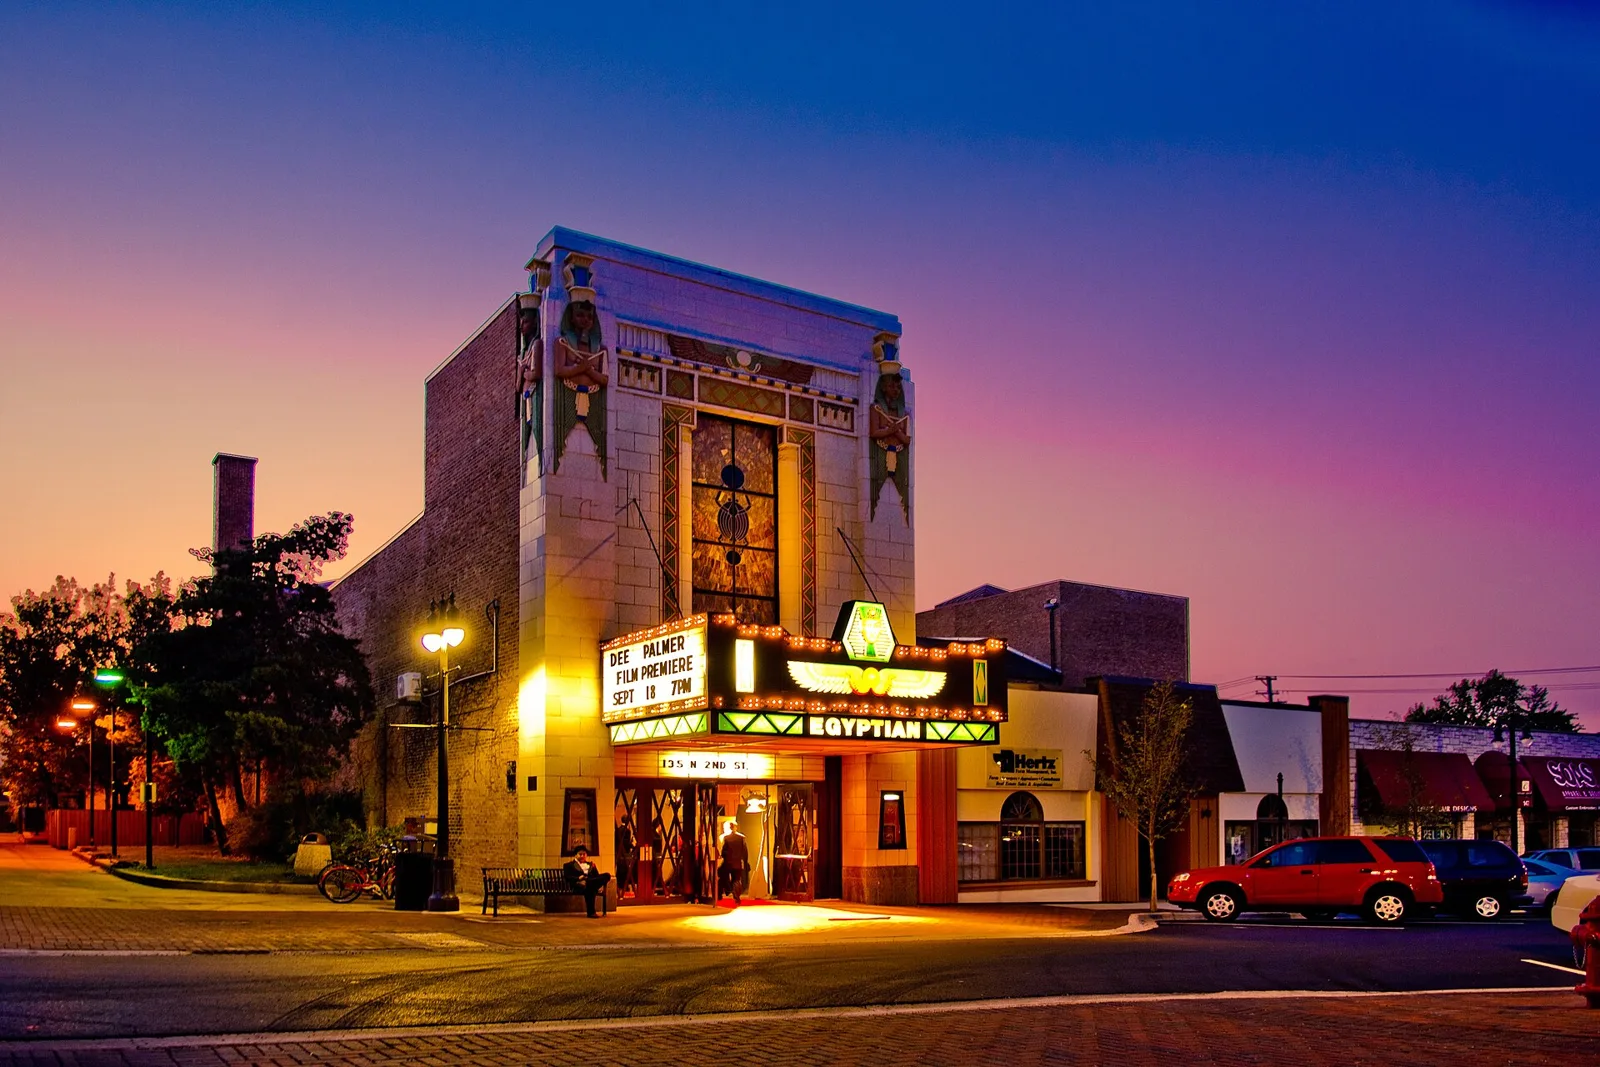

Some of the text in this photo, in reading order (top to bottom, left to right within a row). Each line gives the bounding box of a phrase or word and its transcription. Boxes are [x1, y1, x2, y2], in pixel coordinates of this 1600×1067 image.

[610, 635, 685, 667] DEE PALMER
[616, 655, 693, 685] FILM PREMIERE
[613, 677, 692, 705] SEPT 18 7PM
[809, 716, 921, 739] EGYPTIAN
[662, 759, 683, 768] 135
[690, 760, 697, 769] N
[704, 760, 726, 769] 2ND
[1015, 754, 1056, 769] Hertz
